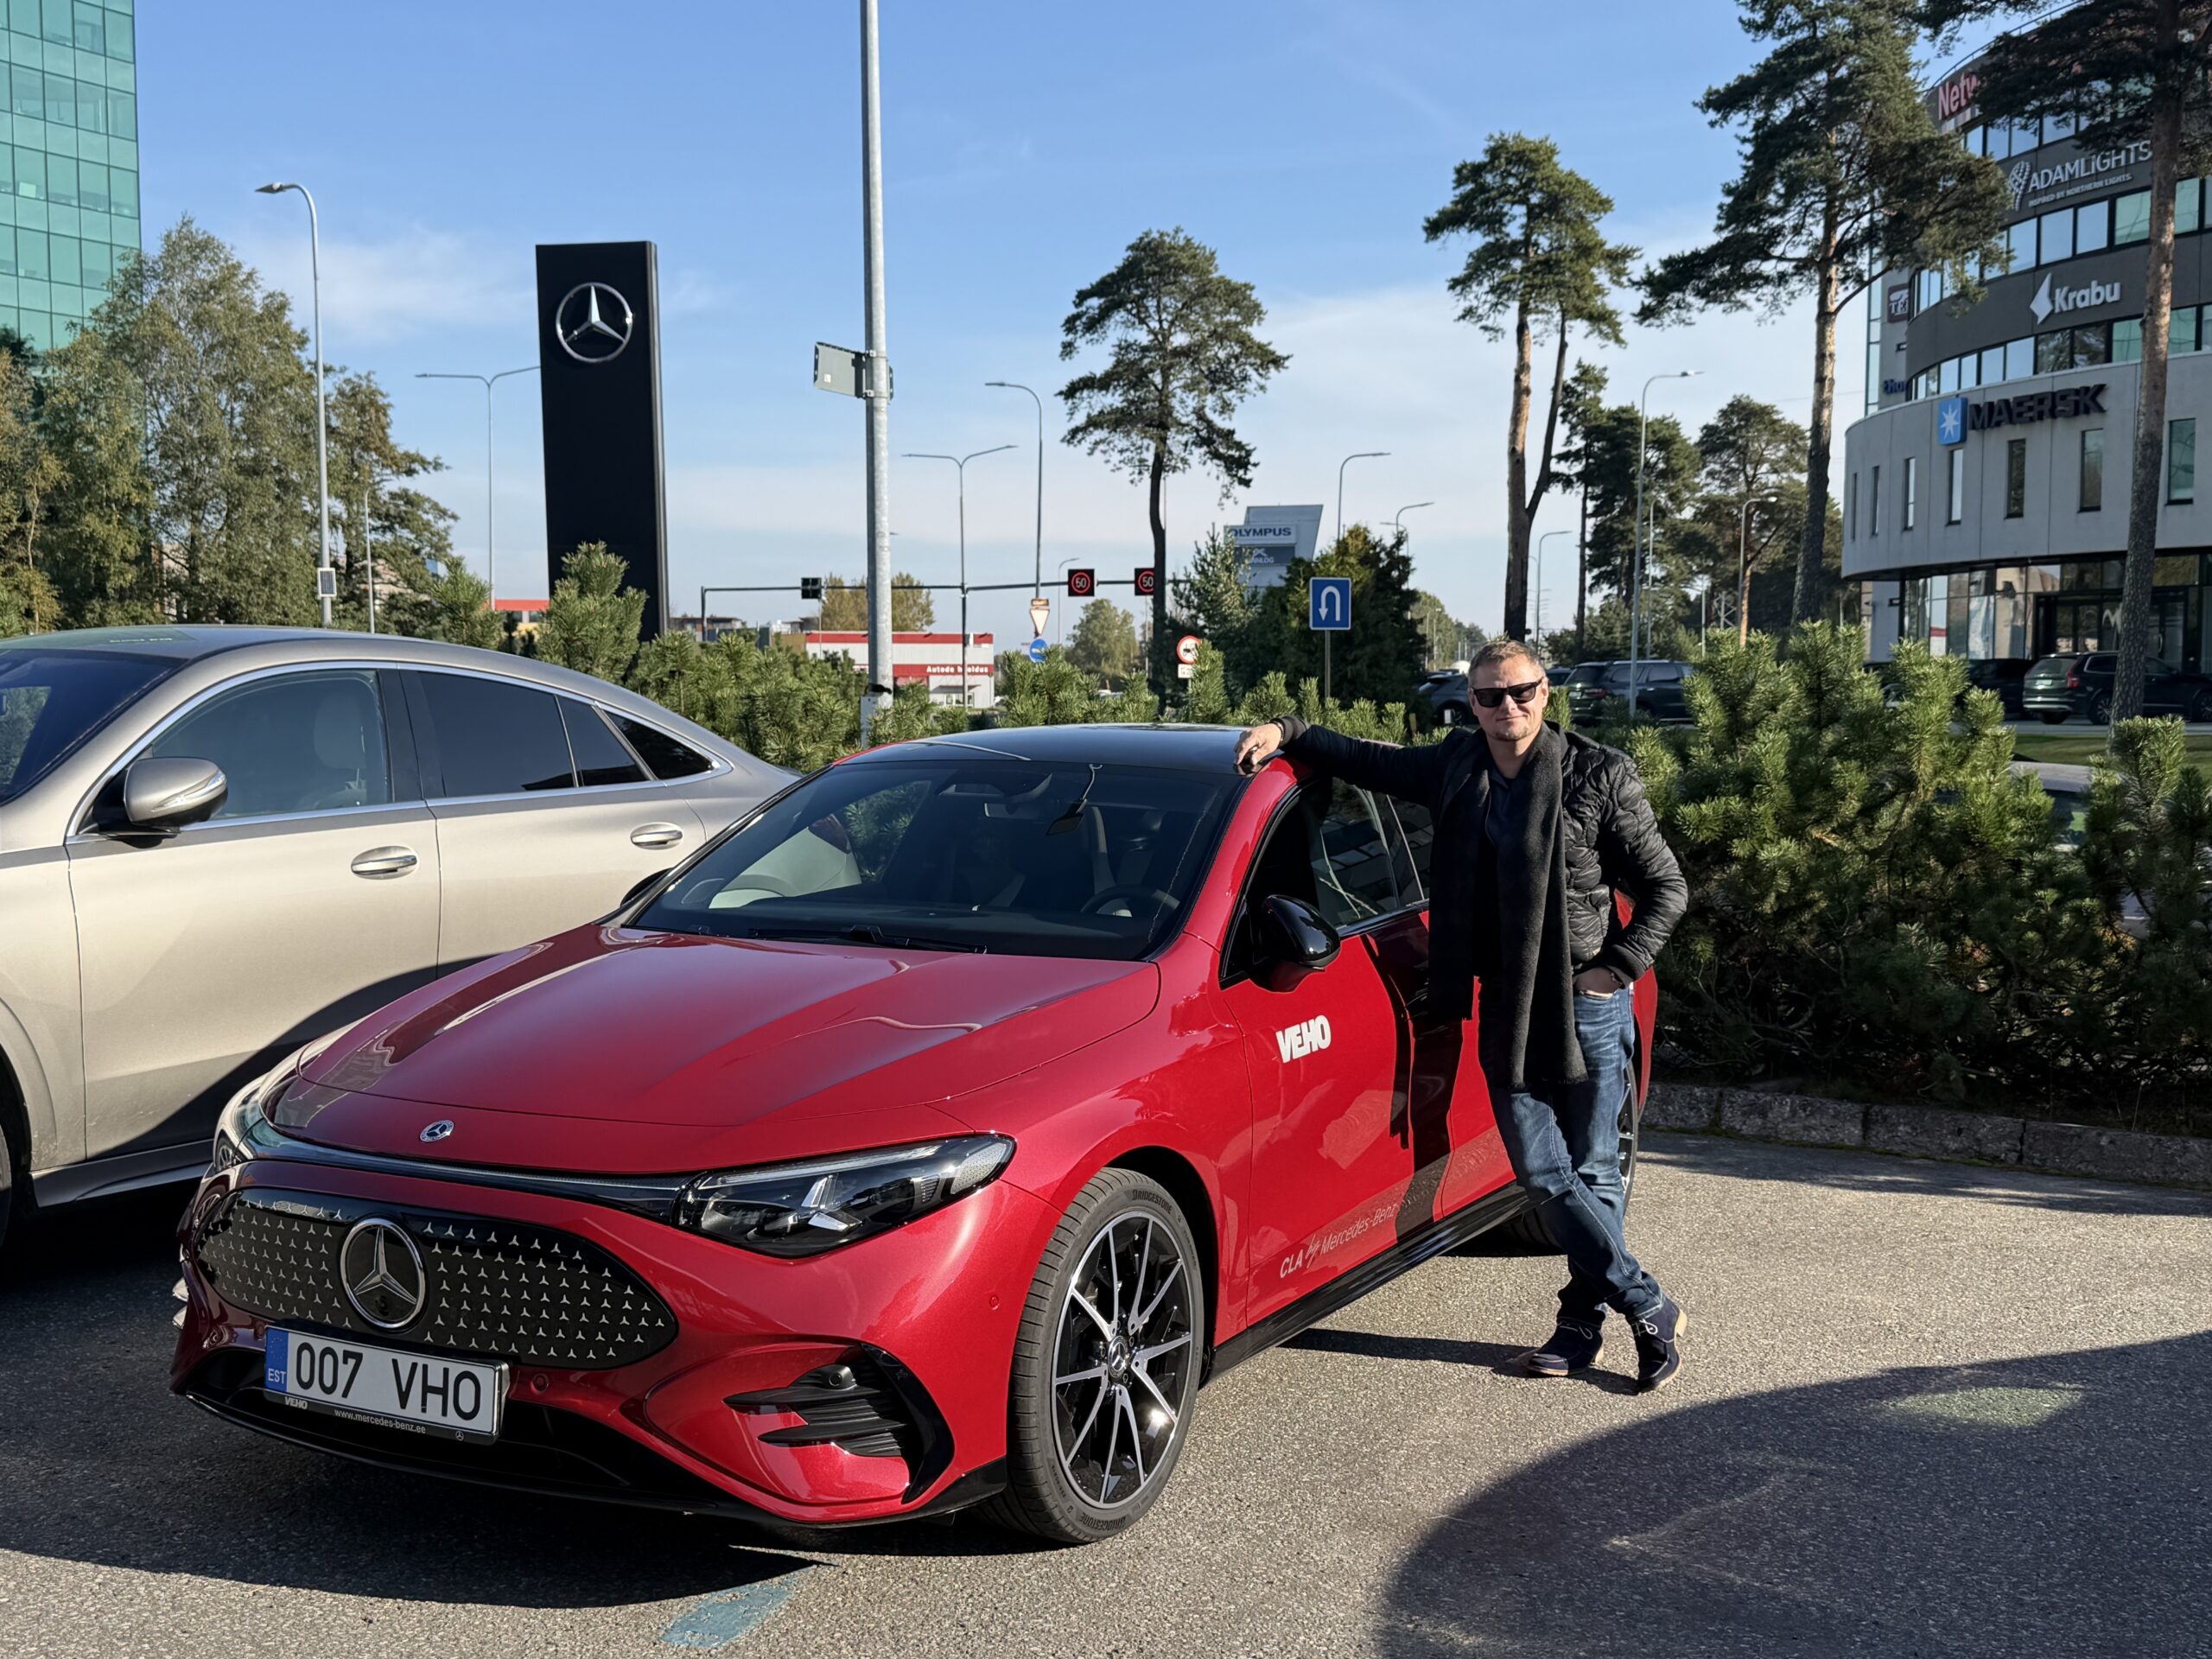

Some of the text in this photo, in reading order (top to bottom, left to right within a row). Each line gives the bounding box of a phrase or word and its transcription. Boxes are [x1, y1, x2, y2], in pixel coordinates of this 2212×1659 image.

[2054, 280, 2121, 314] Krabu
[1968, 384, 2109, 430] MAERSK
[1228, 527, 1292, 537] OLYMPUS
[1075, 577, 1087, 588] 50
[1142, 575, 1154, 588] 50
[1275, 1014, 1332, 1064] VEHO
[1132, 1189, 1173, 1215] BRIDGESTONE
[1280, 1249, 1304, 1278] CLA
[1320, 1204, 1398, 1255] Mercedes-Benz
[268, 1368, 287, 1384] EST
[296, 1342, 481, 1421] 007 VHO
[284, 1395, 308, 1410] VEHO
[334, 1408, 426, 1434] www.mercedes-benz.ee
